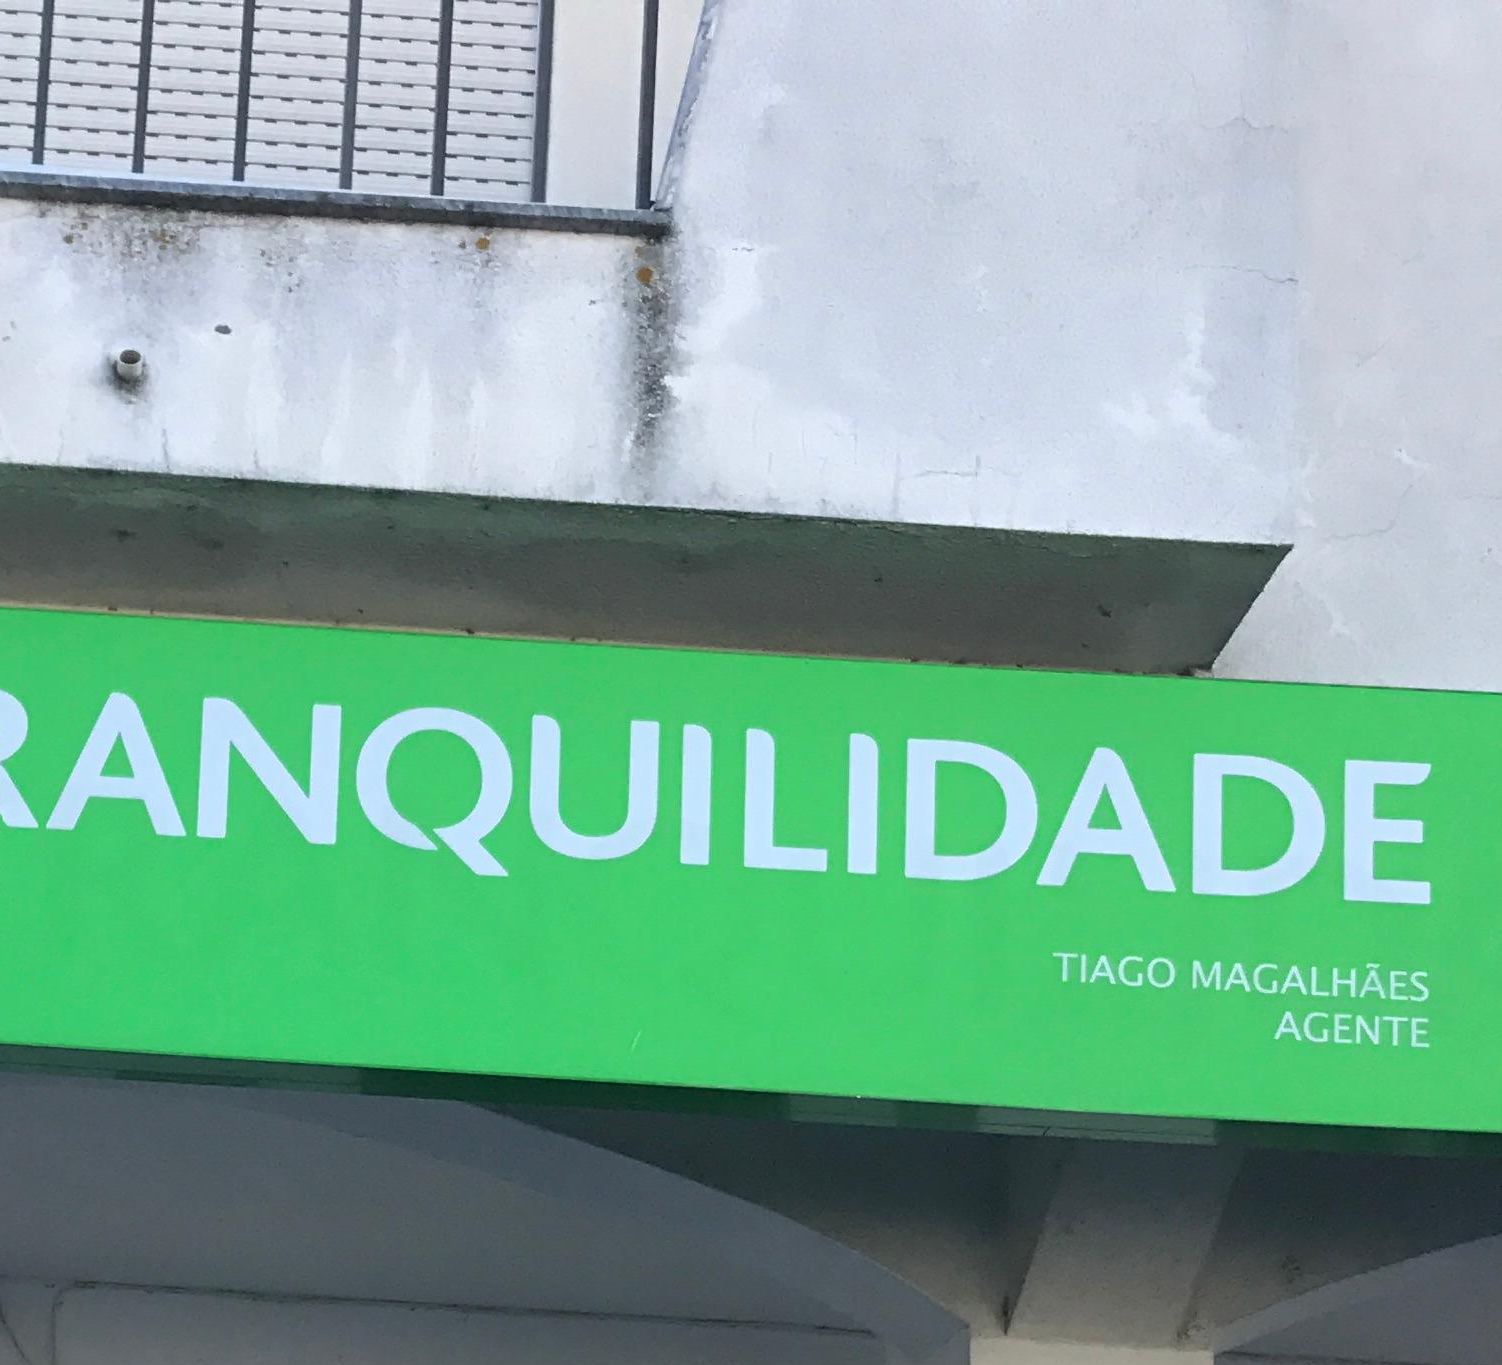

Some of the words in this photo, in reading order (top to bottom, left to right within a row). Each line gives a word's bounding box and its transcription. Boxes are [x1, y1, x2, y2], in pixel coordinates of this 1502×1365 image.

[1052, 952, 1176, 988] TIAGO
[1192, 960, 1429, 1002] MAGALHÃES
[1274, 1011, 1430, 1048] AGENTE
